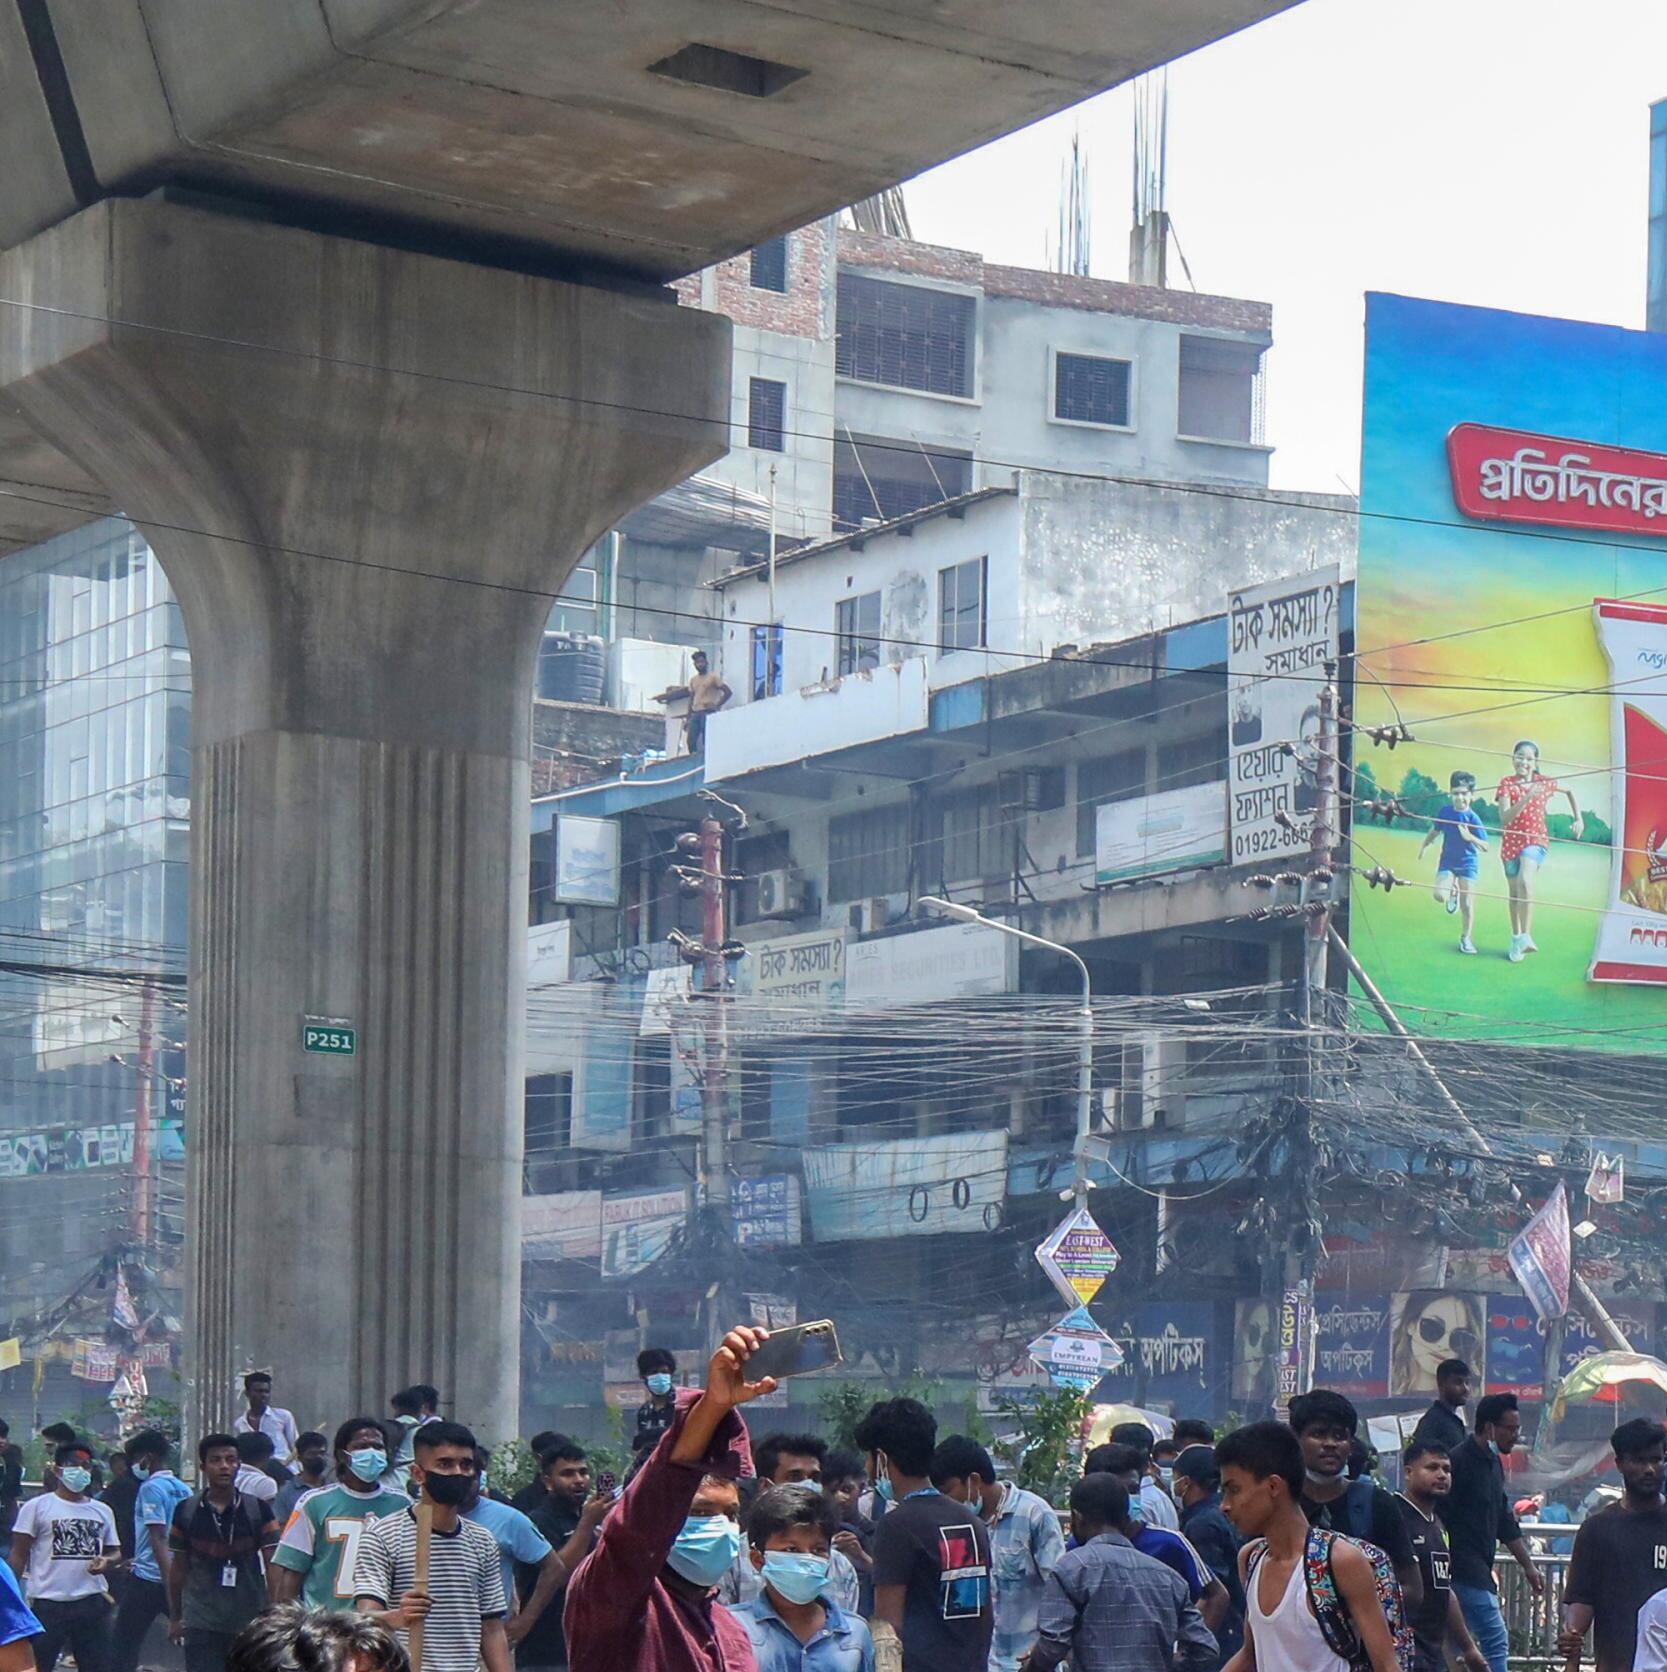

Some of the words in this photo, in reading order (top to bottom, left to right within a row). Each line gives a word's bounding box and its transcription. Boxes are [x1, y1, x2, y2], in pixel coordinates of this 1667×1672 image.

[1231, 596, 1263, 654] টাক
[1265, 640, 1329, 674] সমাধান
[760, 944, 786, 980] টাক
[307, 1030, 352, 1050] P251
[1054, 1352, 1098, 1363] EMPYREAN
